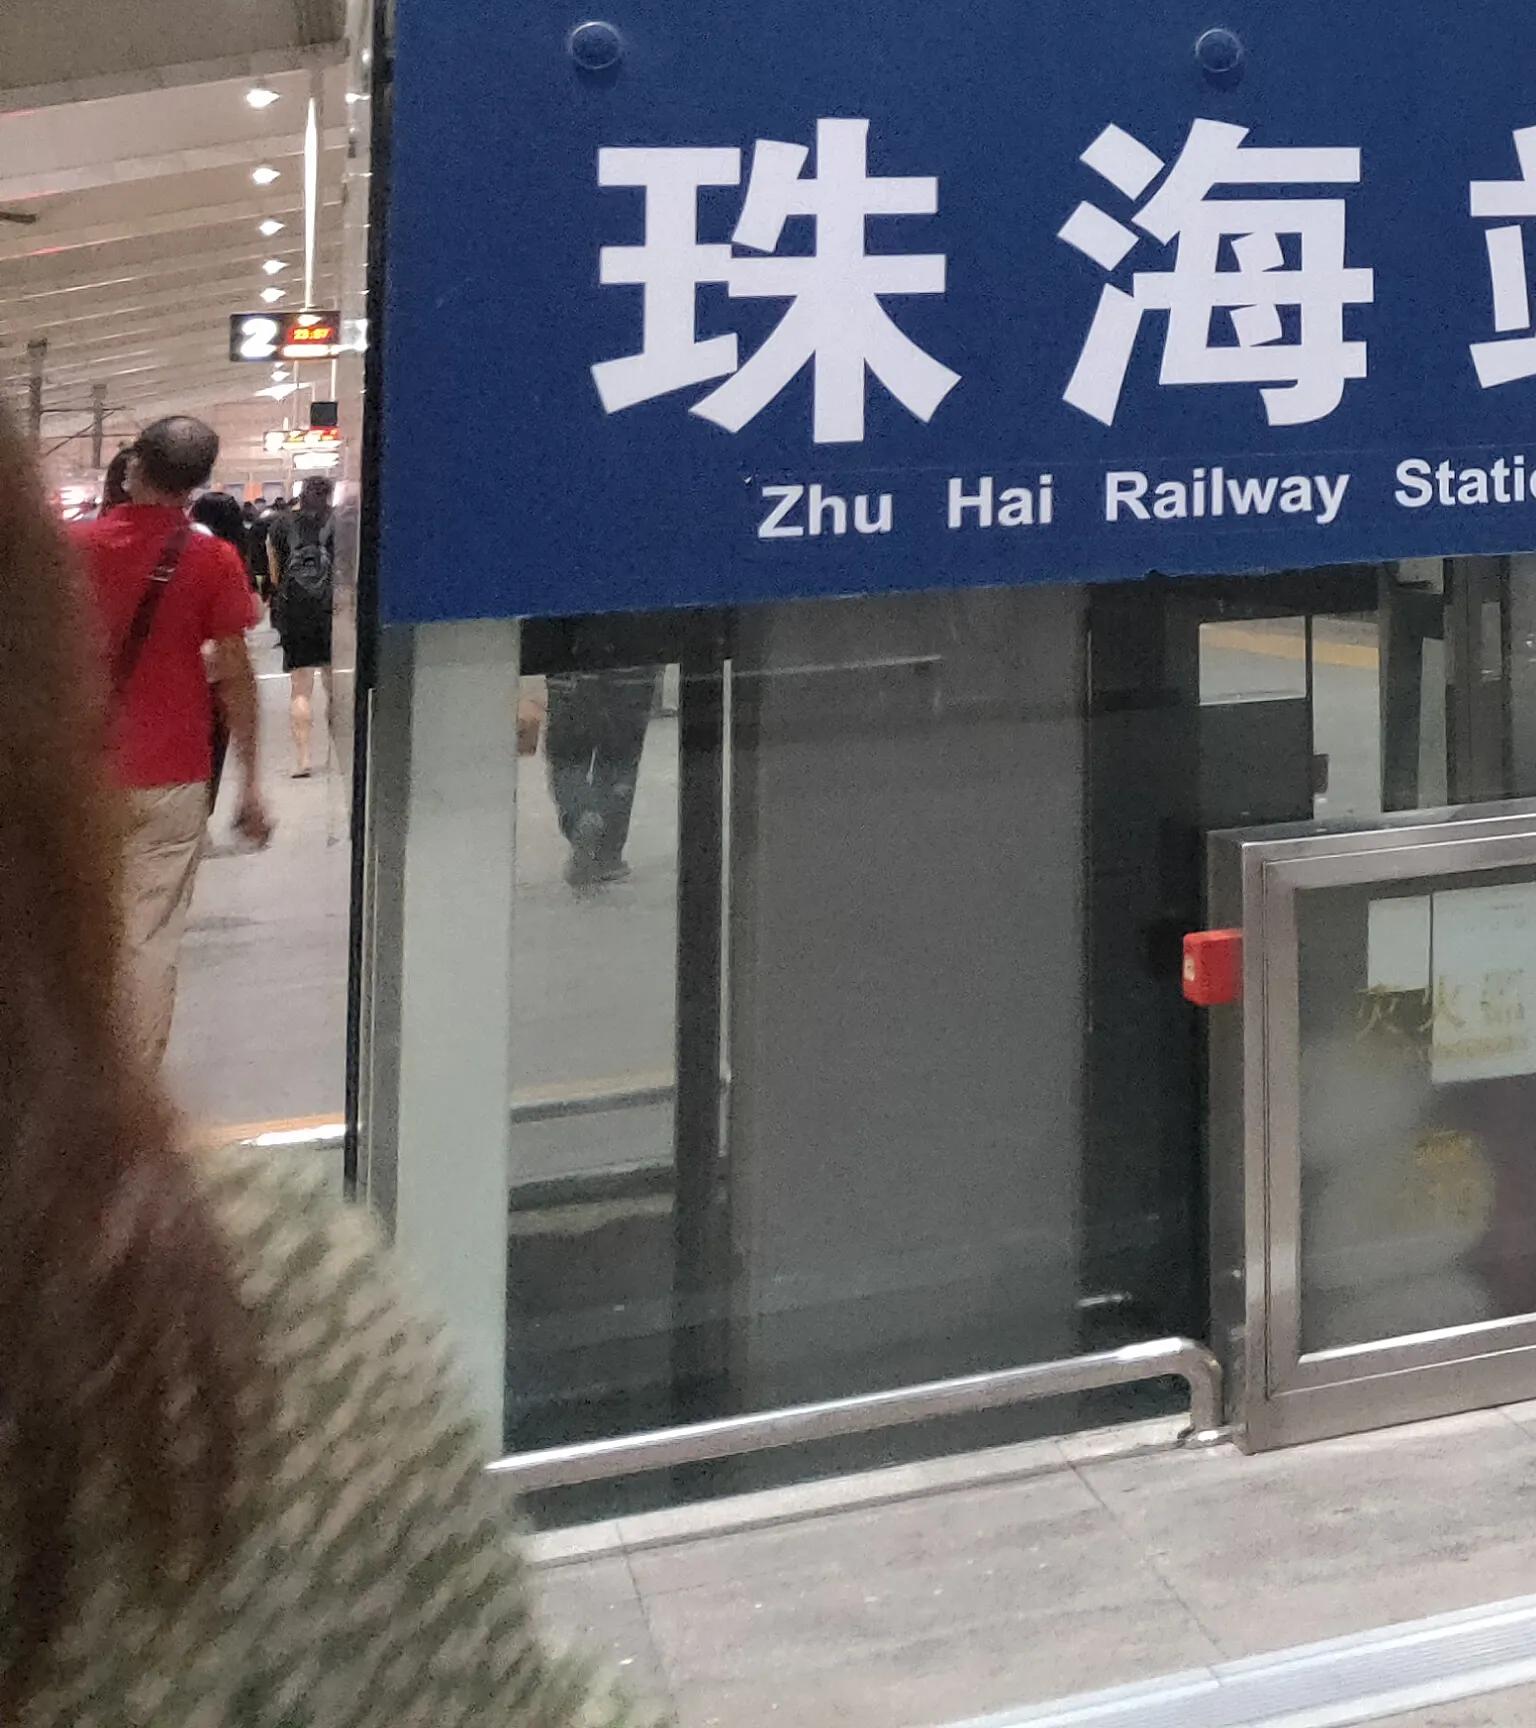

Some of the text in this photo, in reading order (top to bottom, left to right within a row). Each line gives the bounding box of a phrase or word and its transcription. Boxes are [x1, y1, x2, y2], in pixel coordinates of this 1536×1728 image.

[241, 318, 277, 358] 2
[758, 484, 893, 538] Zhu
[949, 474, 1052, 529] Hai
[1105, 467, 1350, 524] Railway
